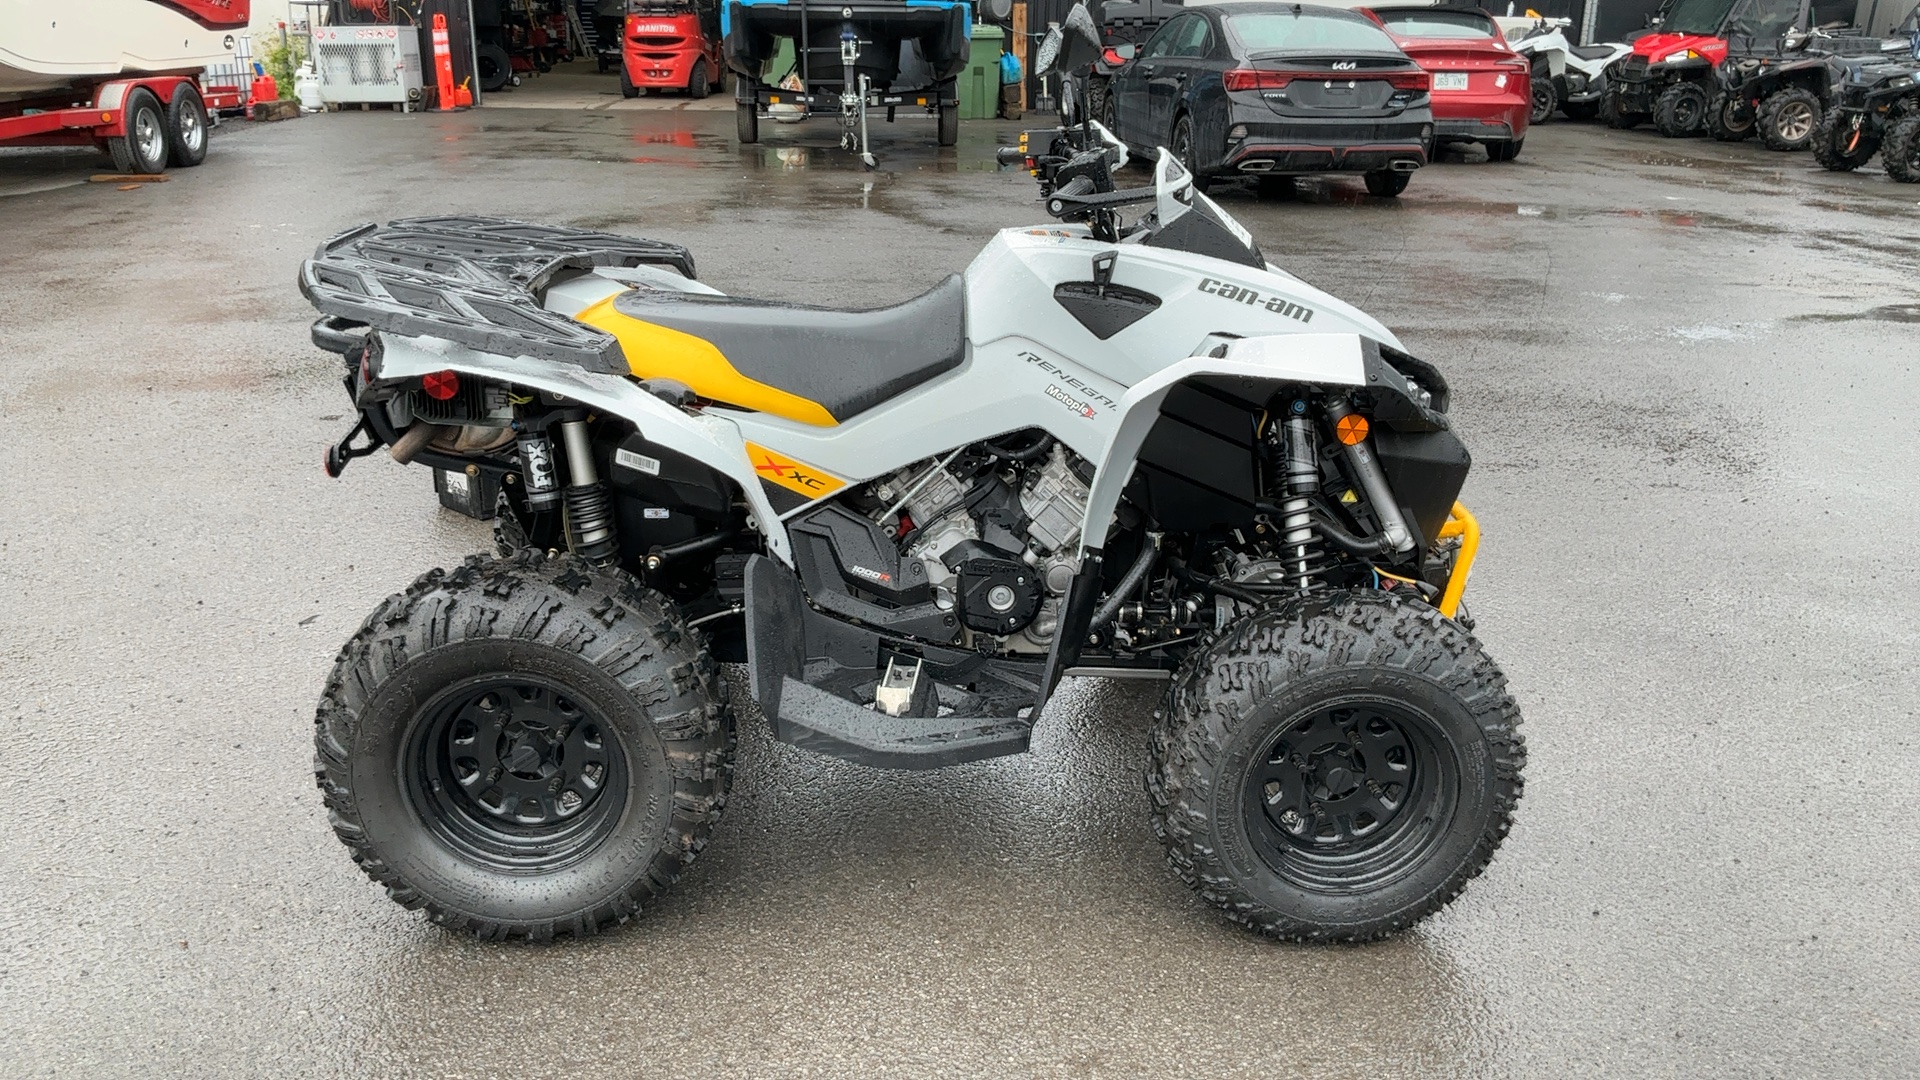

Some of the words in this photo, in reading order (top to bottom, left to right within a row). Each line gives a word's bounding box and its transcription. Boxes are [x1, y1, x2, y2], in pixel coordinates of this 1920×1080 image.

[636, 24, 676, 33] MANITOU
[1435, 77, 1449, 87] J69
[1197, 277, 1314, 324] can-am
[1044, 384, 1097, 420] Motoplex
[526, 442, 553, 488] FOX
[755, 455, 796, 476] X
[786, 471, 826, 491] XC
[851, 565, 891, 582] 1000R
